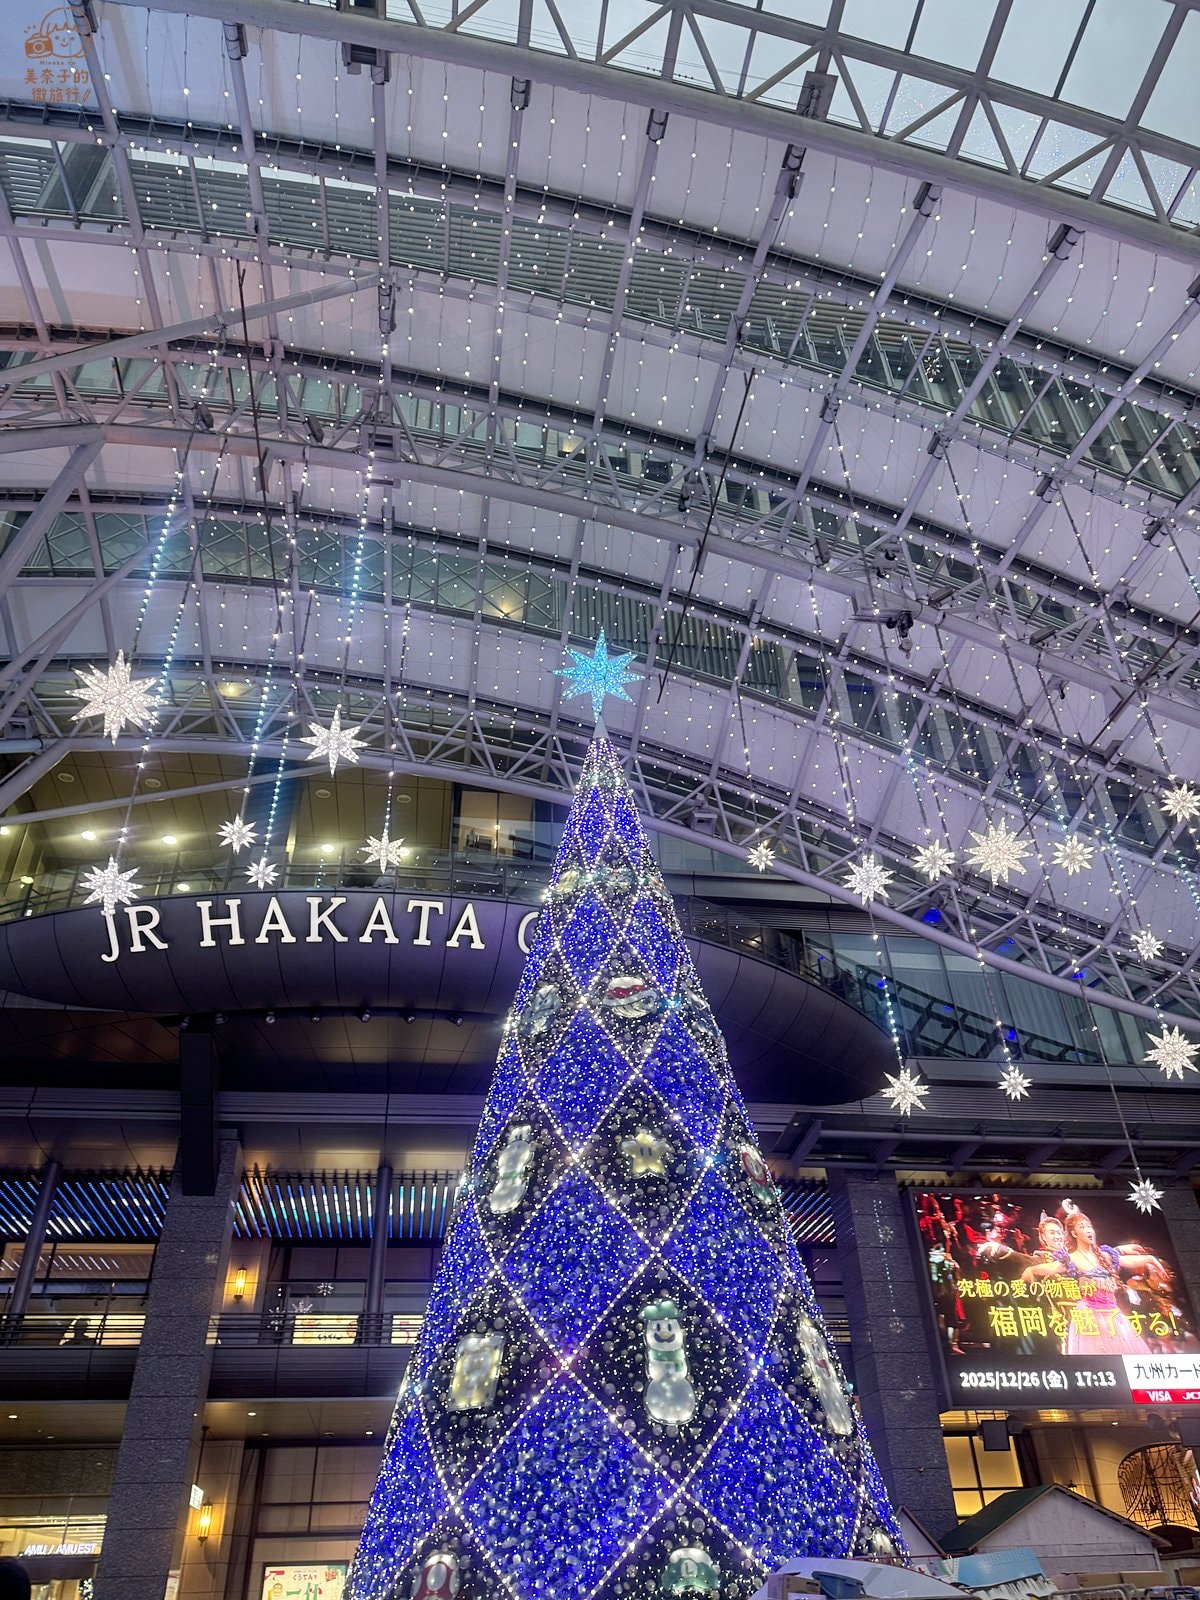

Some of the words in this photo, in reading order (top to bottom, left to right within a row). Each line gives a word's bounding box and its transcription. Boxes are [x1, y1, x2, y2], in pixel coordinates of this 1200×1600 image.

[100, 904, 168, 963] JR
[196, 896, 486, 950] HAKATA
[957, 1278, 1097, 1300] 究極の愛の物語が
[1075, 1371, 1117, 1387] 17:13
[1145, 1390, 1173, 1402] VISA
